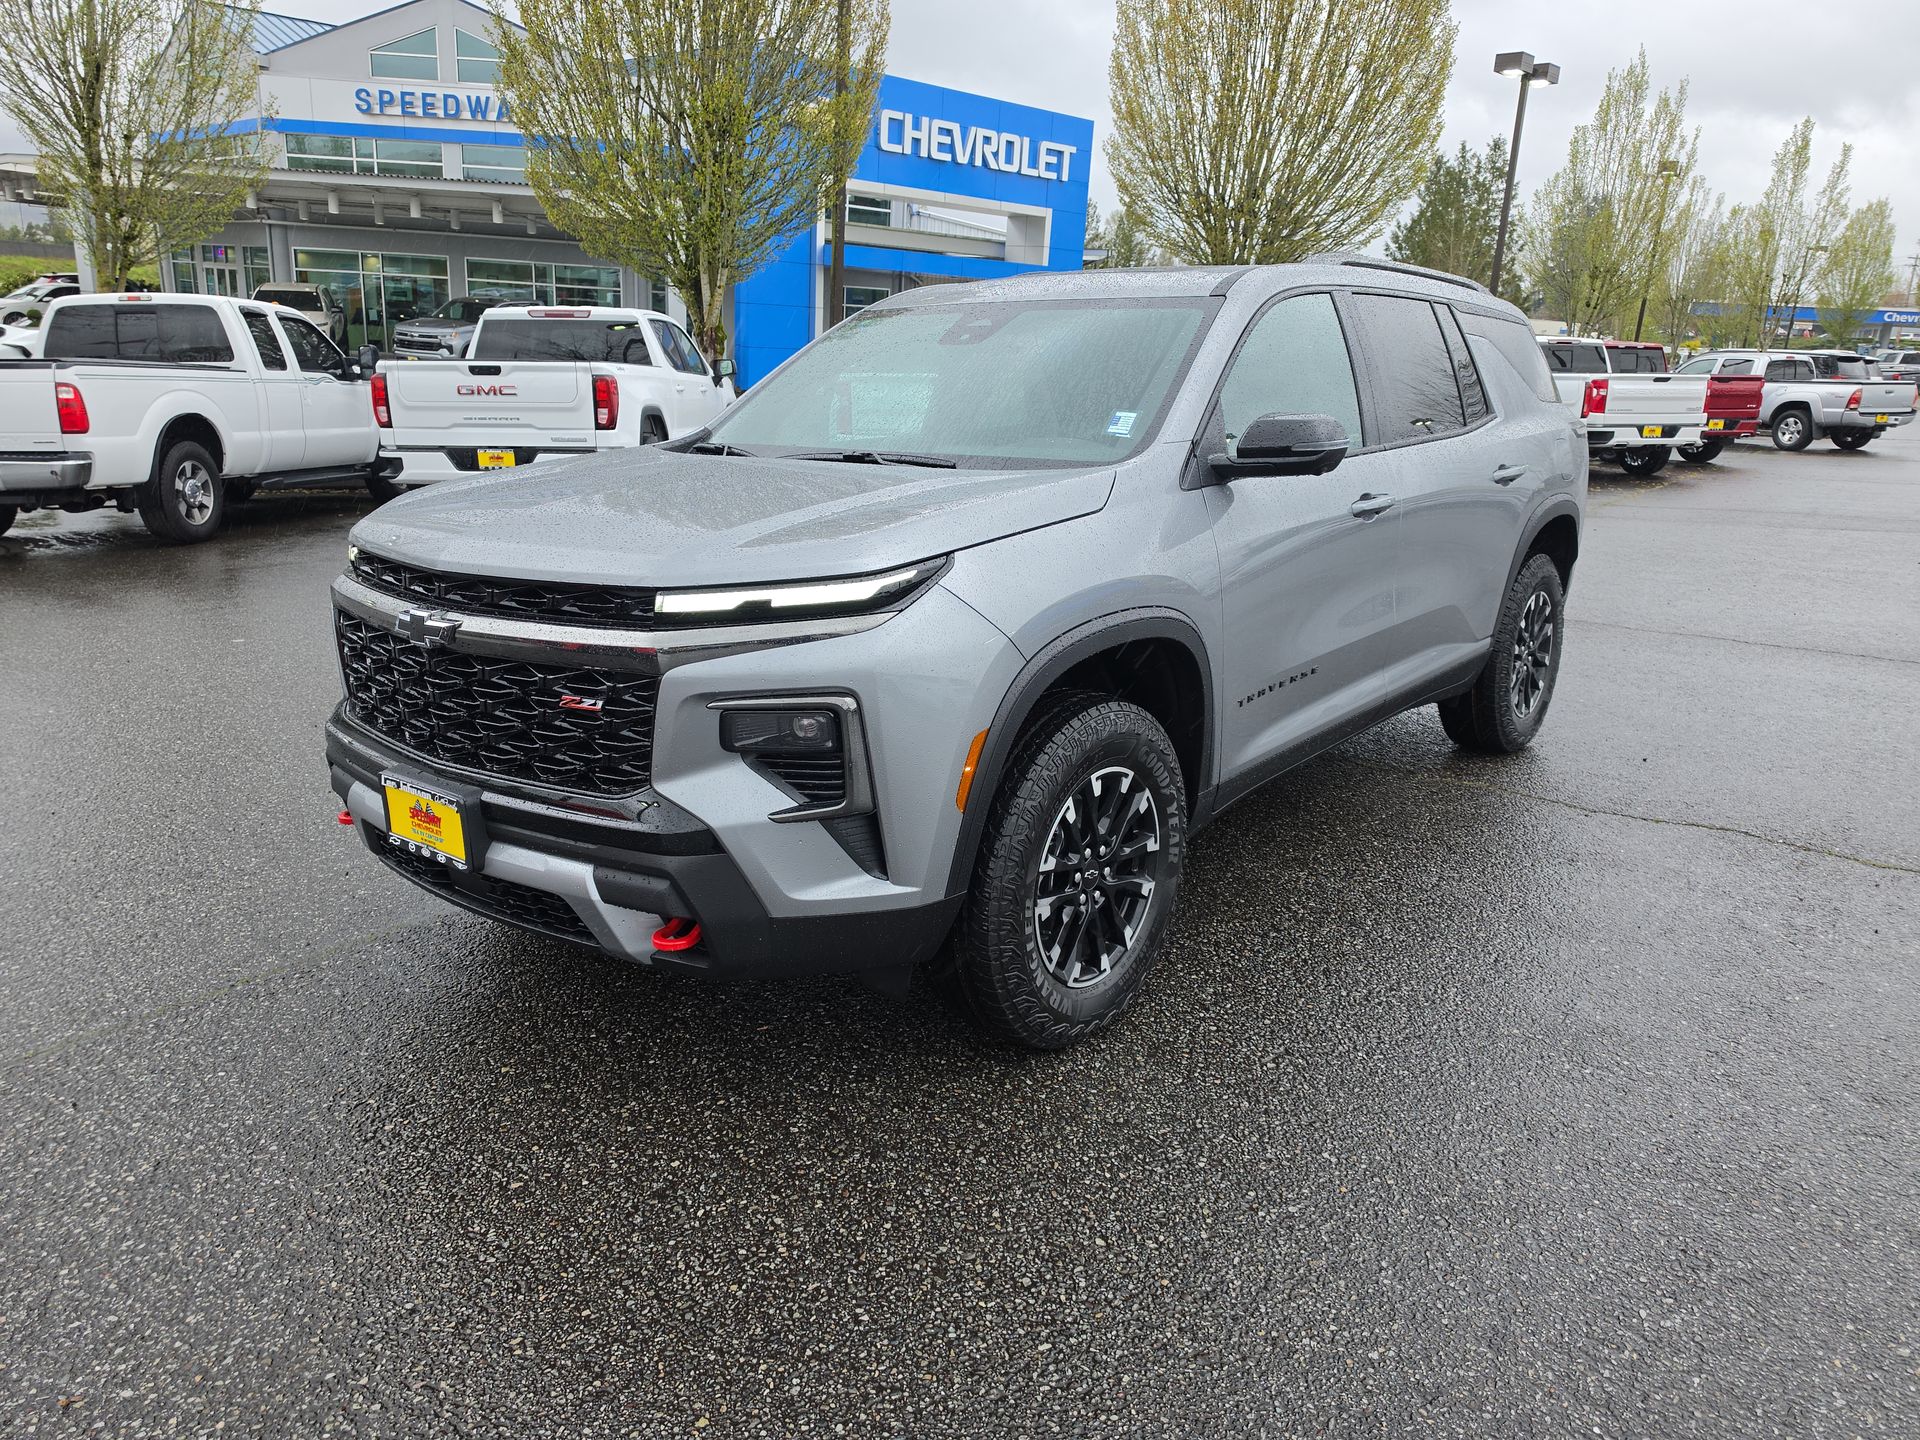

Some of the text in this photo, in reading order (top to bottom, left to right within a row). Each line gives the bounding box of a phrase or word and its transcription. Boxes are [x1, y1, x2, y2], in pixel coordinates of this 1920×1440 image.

[354, 88, 520, 123] SPEEDWA
[879, 109, 1077, 182] CHEVROLET
[457, 384, 518, 397] GMC
[1237, 665, 1319, 708] TRAVERSE
[1025, 898, 1073, 1016] WRANGLER
